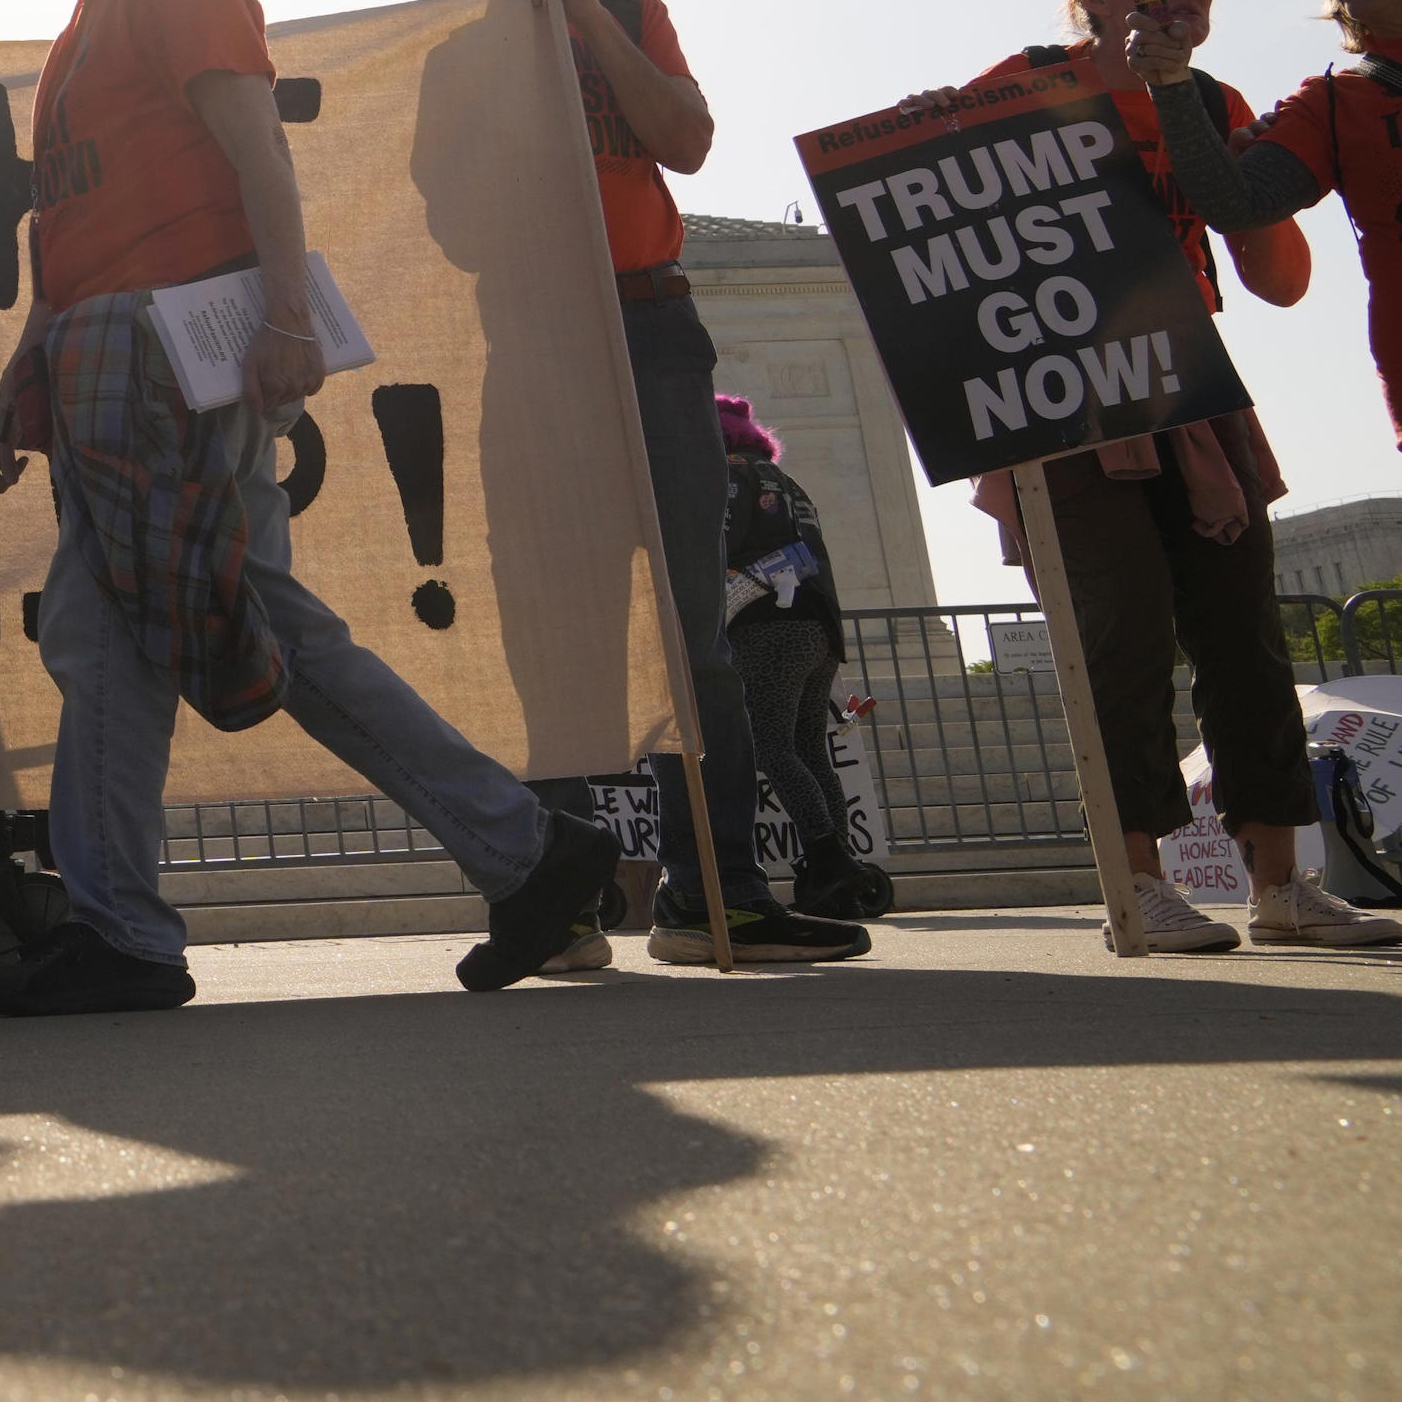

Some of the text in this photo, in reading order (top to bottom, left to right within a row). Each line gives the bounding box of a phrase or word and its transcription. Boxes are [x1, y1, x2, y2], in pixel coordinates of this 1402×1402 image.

[834, 119, 1115, 243] TRUMP
[889, 190, 1117, 305] MUST
[976, 274, 1099, 354] GO
[962, 329, 1183, 442] NOW!
[1003, 630, 1035, 642] AREA
[1179, 838, 1233, 862] HONEST
